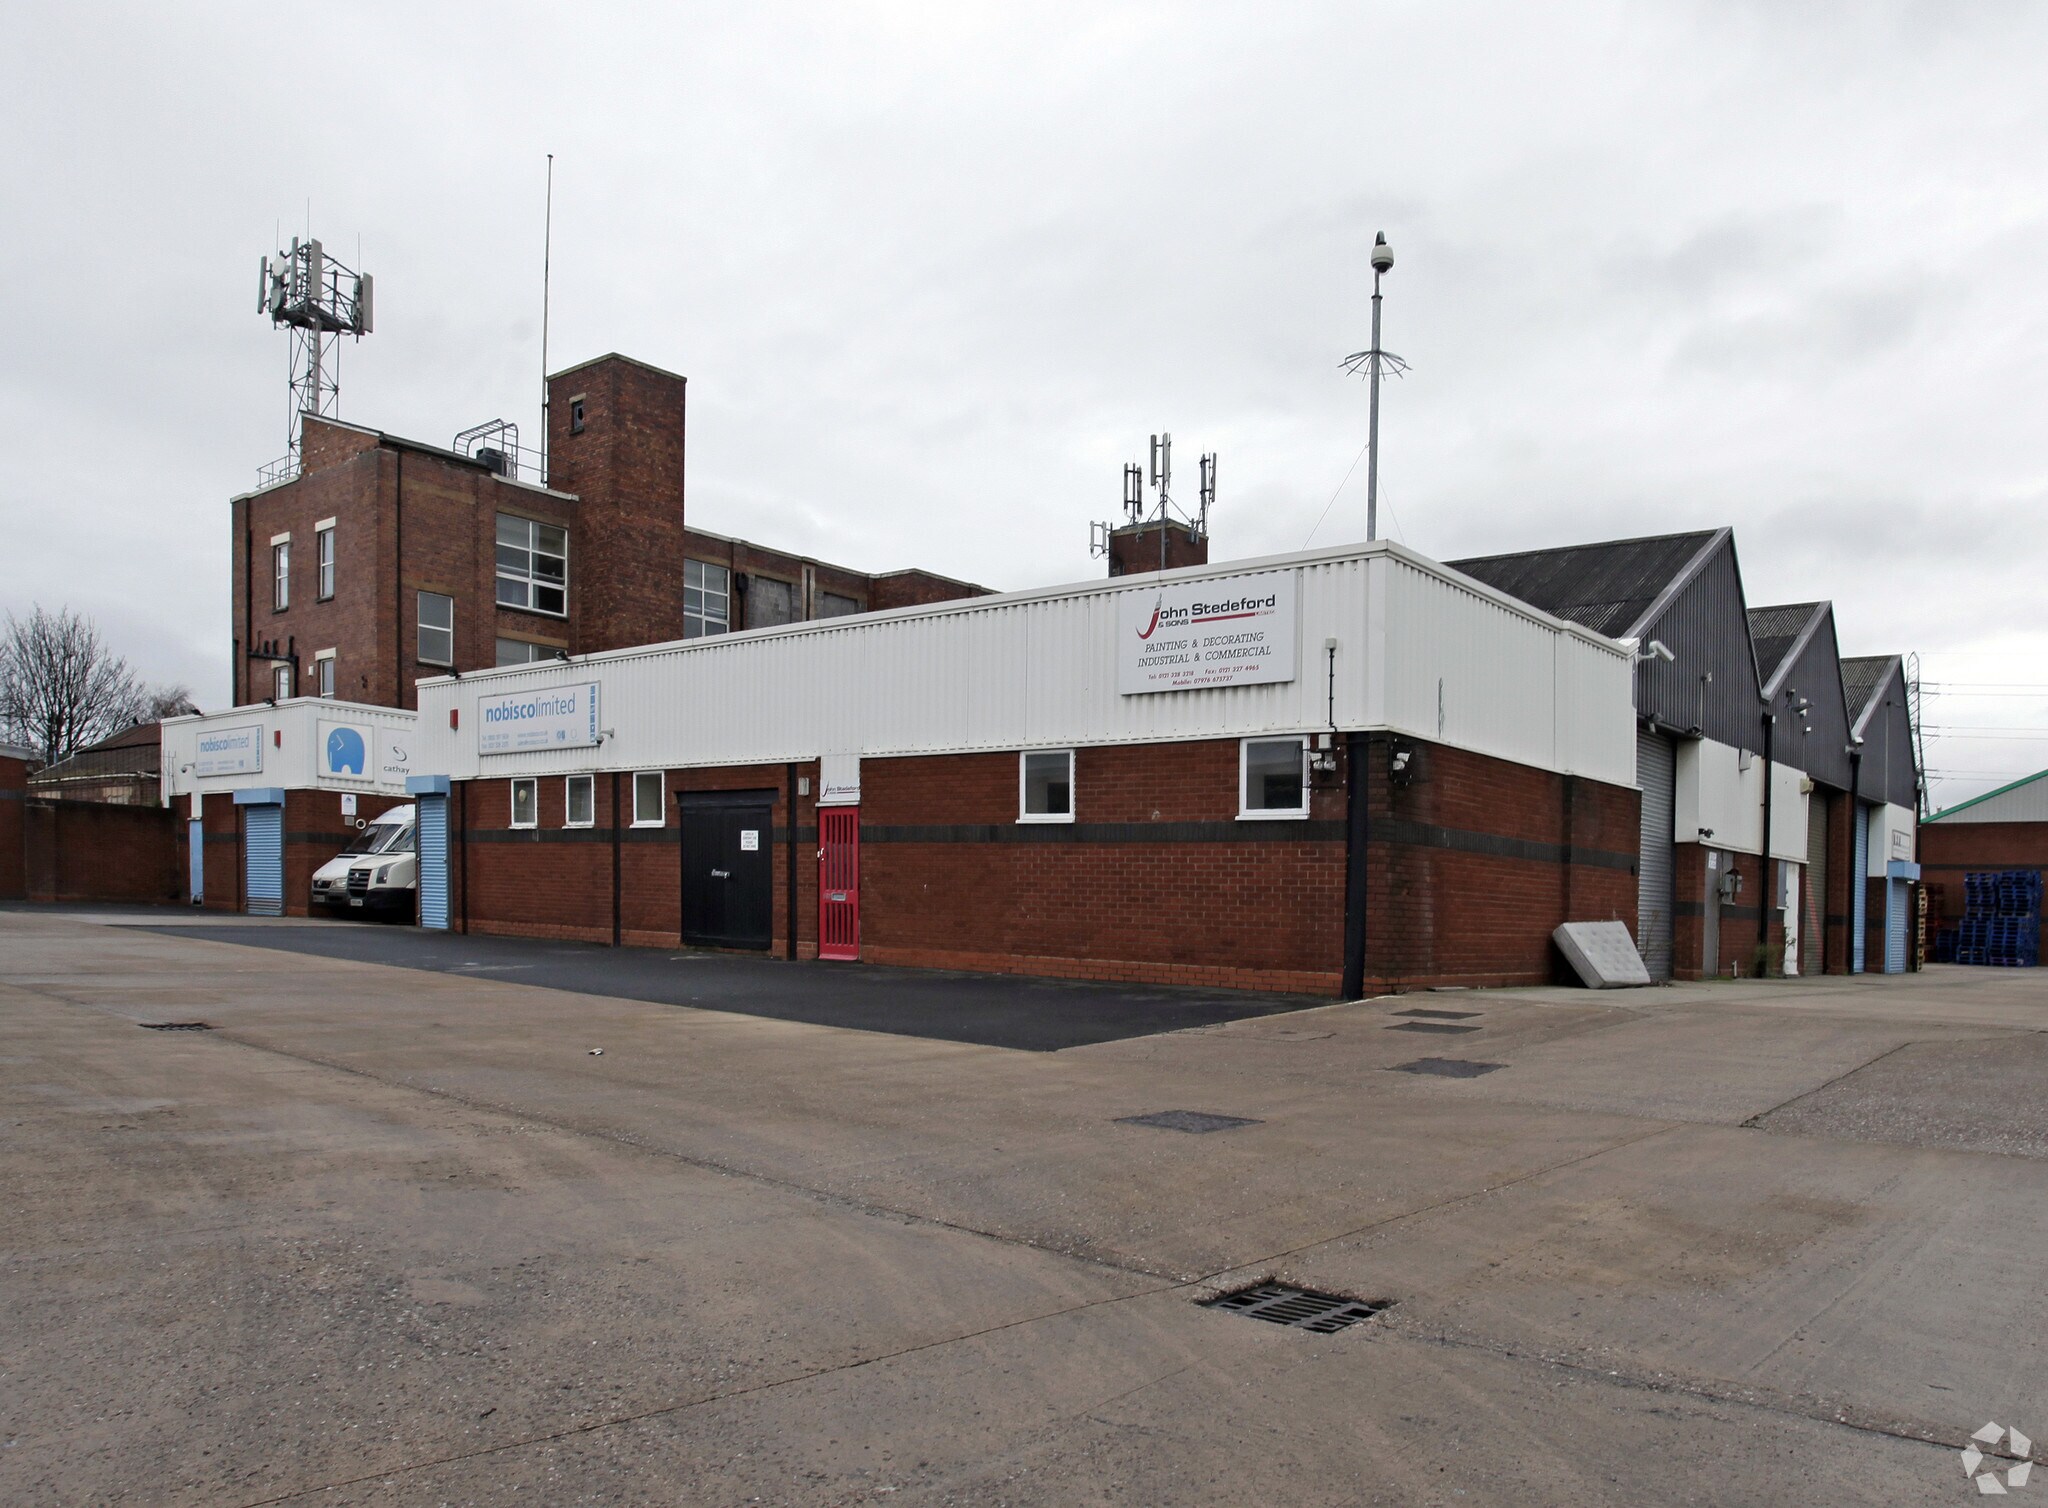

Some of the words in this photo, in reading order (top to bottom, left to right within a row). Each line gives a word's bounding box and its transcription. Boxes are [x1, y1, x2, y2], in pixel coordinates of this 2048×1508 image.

[1136, 592, 1188, 640] John
[1192, 594, 1276, 616] Stedeford
[1166, 618, 1189, 628] SONS
[1145, 640, 1188, 653] PAINTING
[1192, 638, 1198, 648] &
[1203, 632, 1264, 646] DECORATING
[1138, 653, 1190, 668] INDUSTRIAL
[1194, 652, 1200, 662] &
[1205, 646, 1271, 662] COMMERCIAL
[1172, 678, 1192, 686] Mobile:
[486, 692, 576, 722] nobiscolimited
[384, 765, 410, 775] cathay
